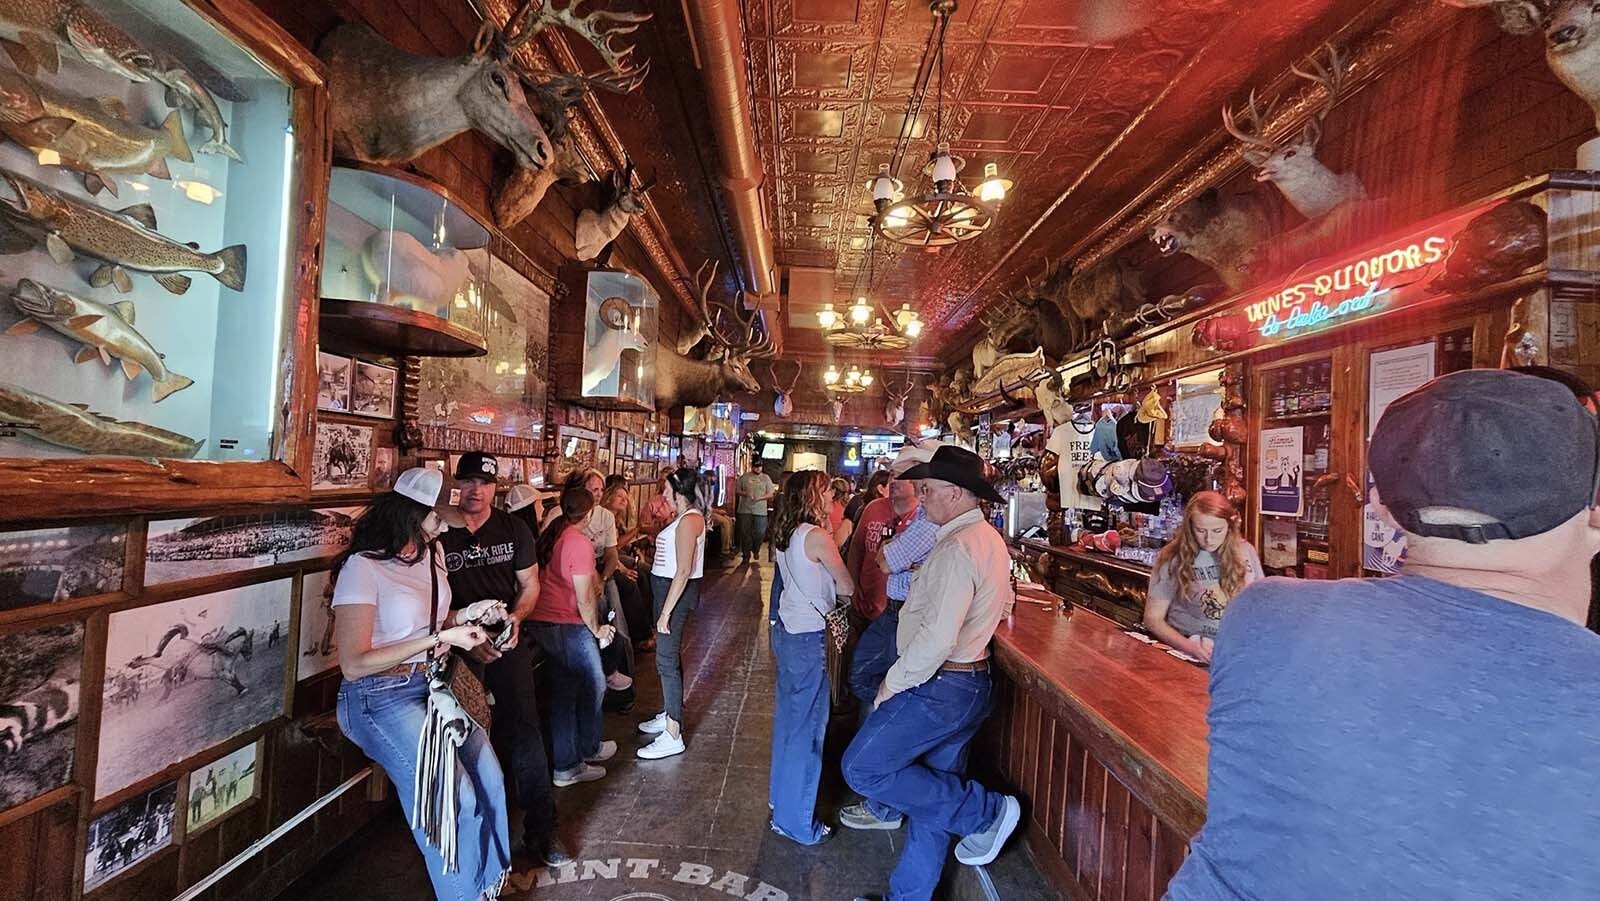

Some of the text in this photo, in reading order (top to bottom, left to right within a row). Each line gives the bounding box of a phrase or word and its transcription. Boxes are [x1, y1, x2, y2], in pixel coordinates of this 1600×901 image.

[1244, 283, 1306, 322] WINES
[1333, 236, 1445, 291] LIQUORS
[1070, 441, 1089, 451] FRE
[491, 542, 514, 556] RIFLE
[487, 553, 514, 565] COMPANY
[501, 857, 790, 901] MINT BAR
